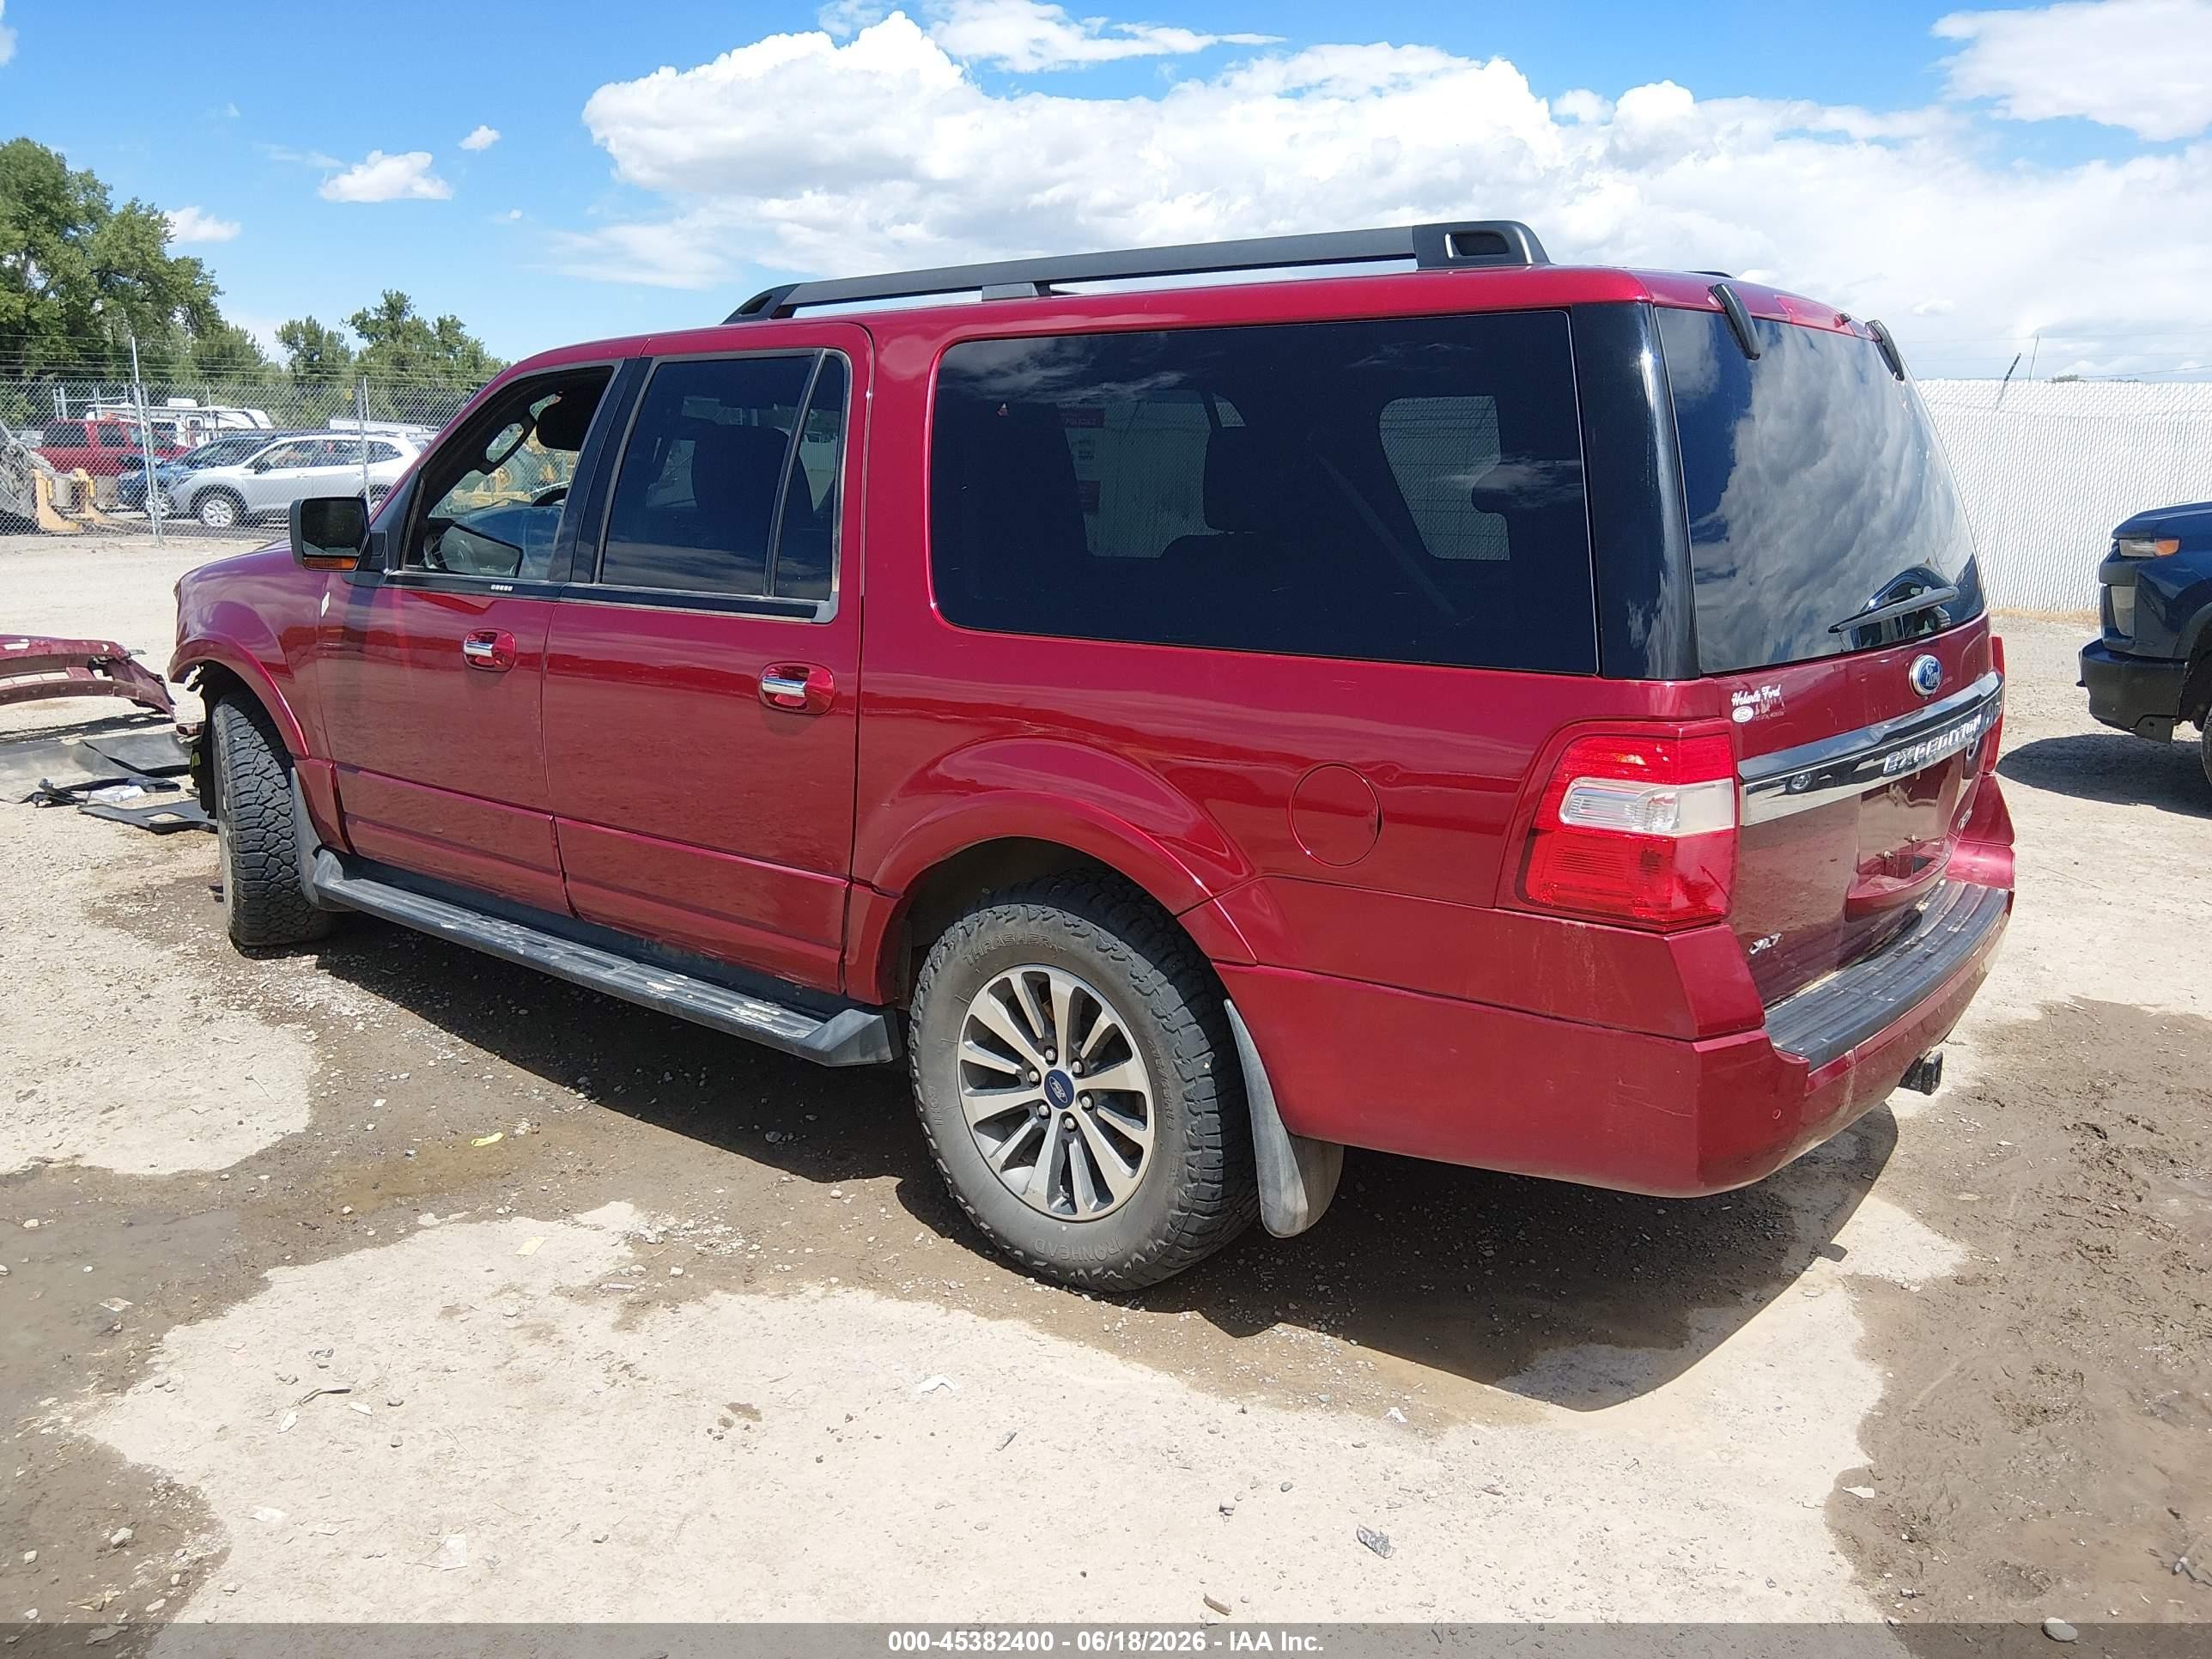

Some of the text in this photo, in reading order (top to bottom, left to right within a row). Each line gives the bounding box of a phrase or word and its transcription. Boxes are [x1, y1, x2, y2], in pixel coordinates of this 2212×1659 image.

[1761, 684, 1782, 700] Ford
[963, 932, 1053, 966] THRASHER
[1034, 1236, 1124, 1262] IRONHEAD
